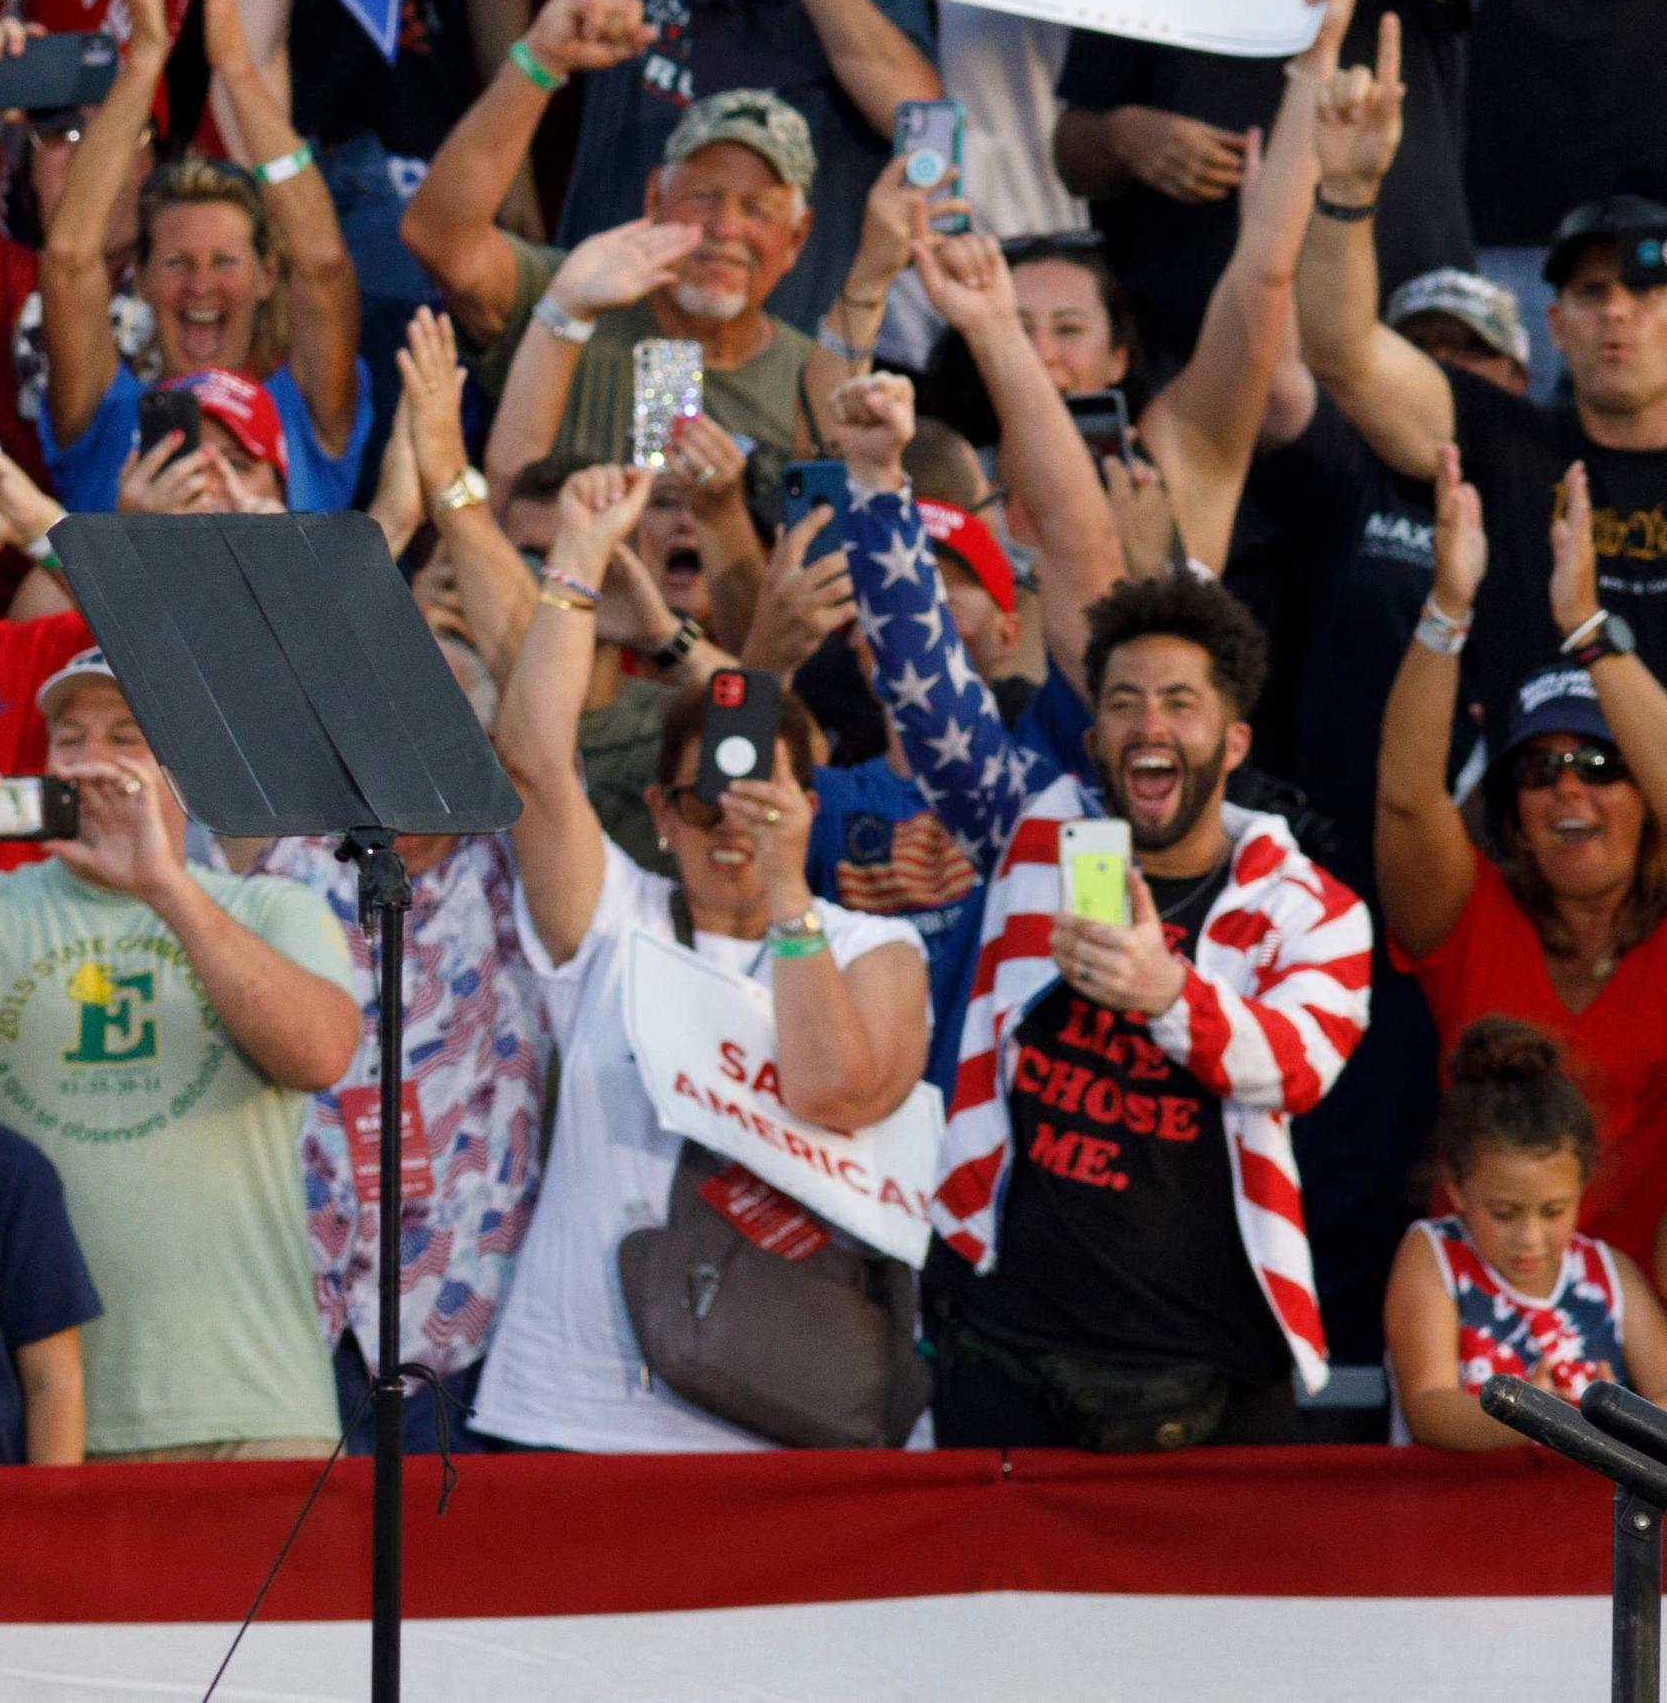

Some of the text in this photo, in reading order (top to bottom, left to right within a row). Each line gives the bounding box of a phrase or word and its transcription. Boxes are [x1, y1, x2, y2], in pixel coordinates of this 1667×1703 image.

[1017, 1045, 1200, 1142] CHOSE
[674, 1071, 933, 1223] AMERICA!
[1028, 1122, 1129, 1191] ME.
